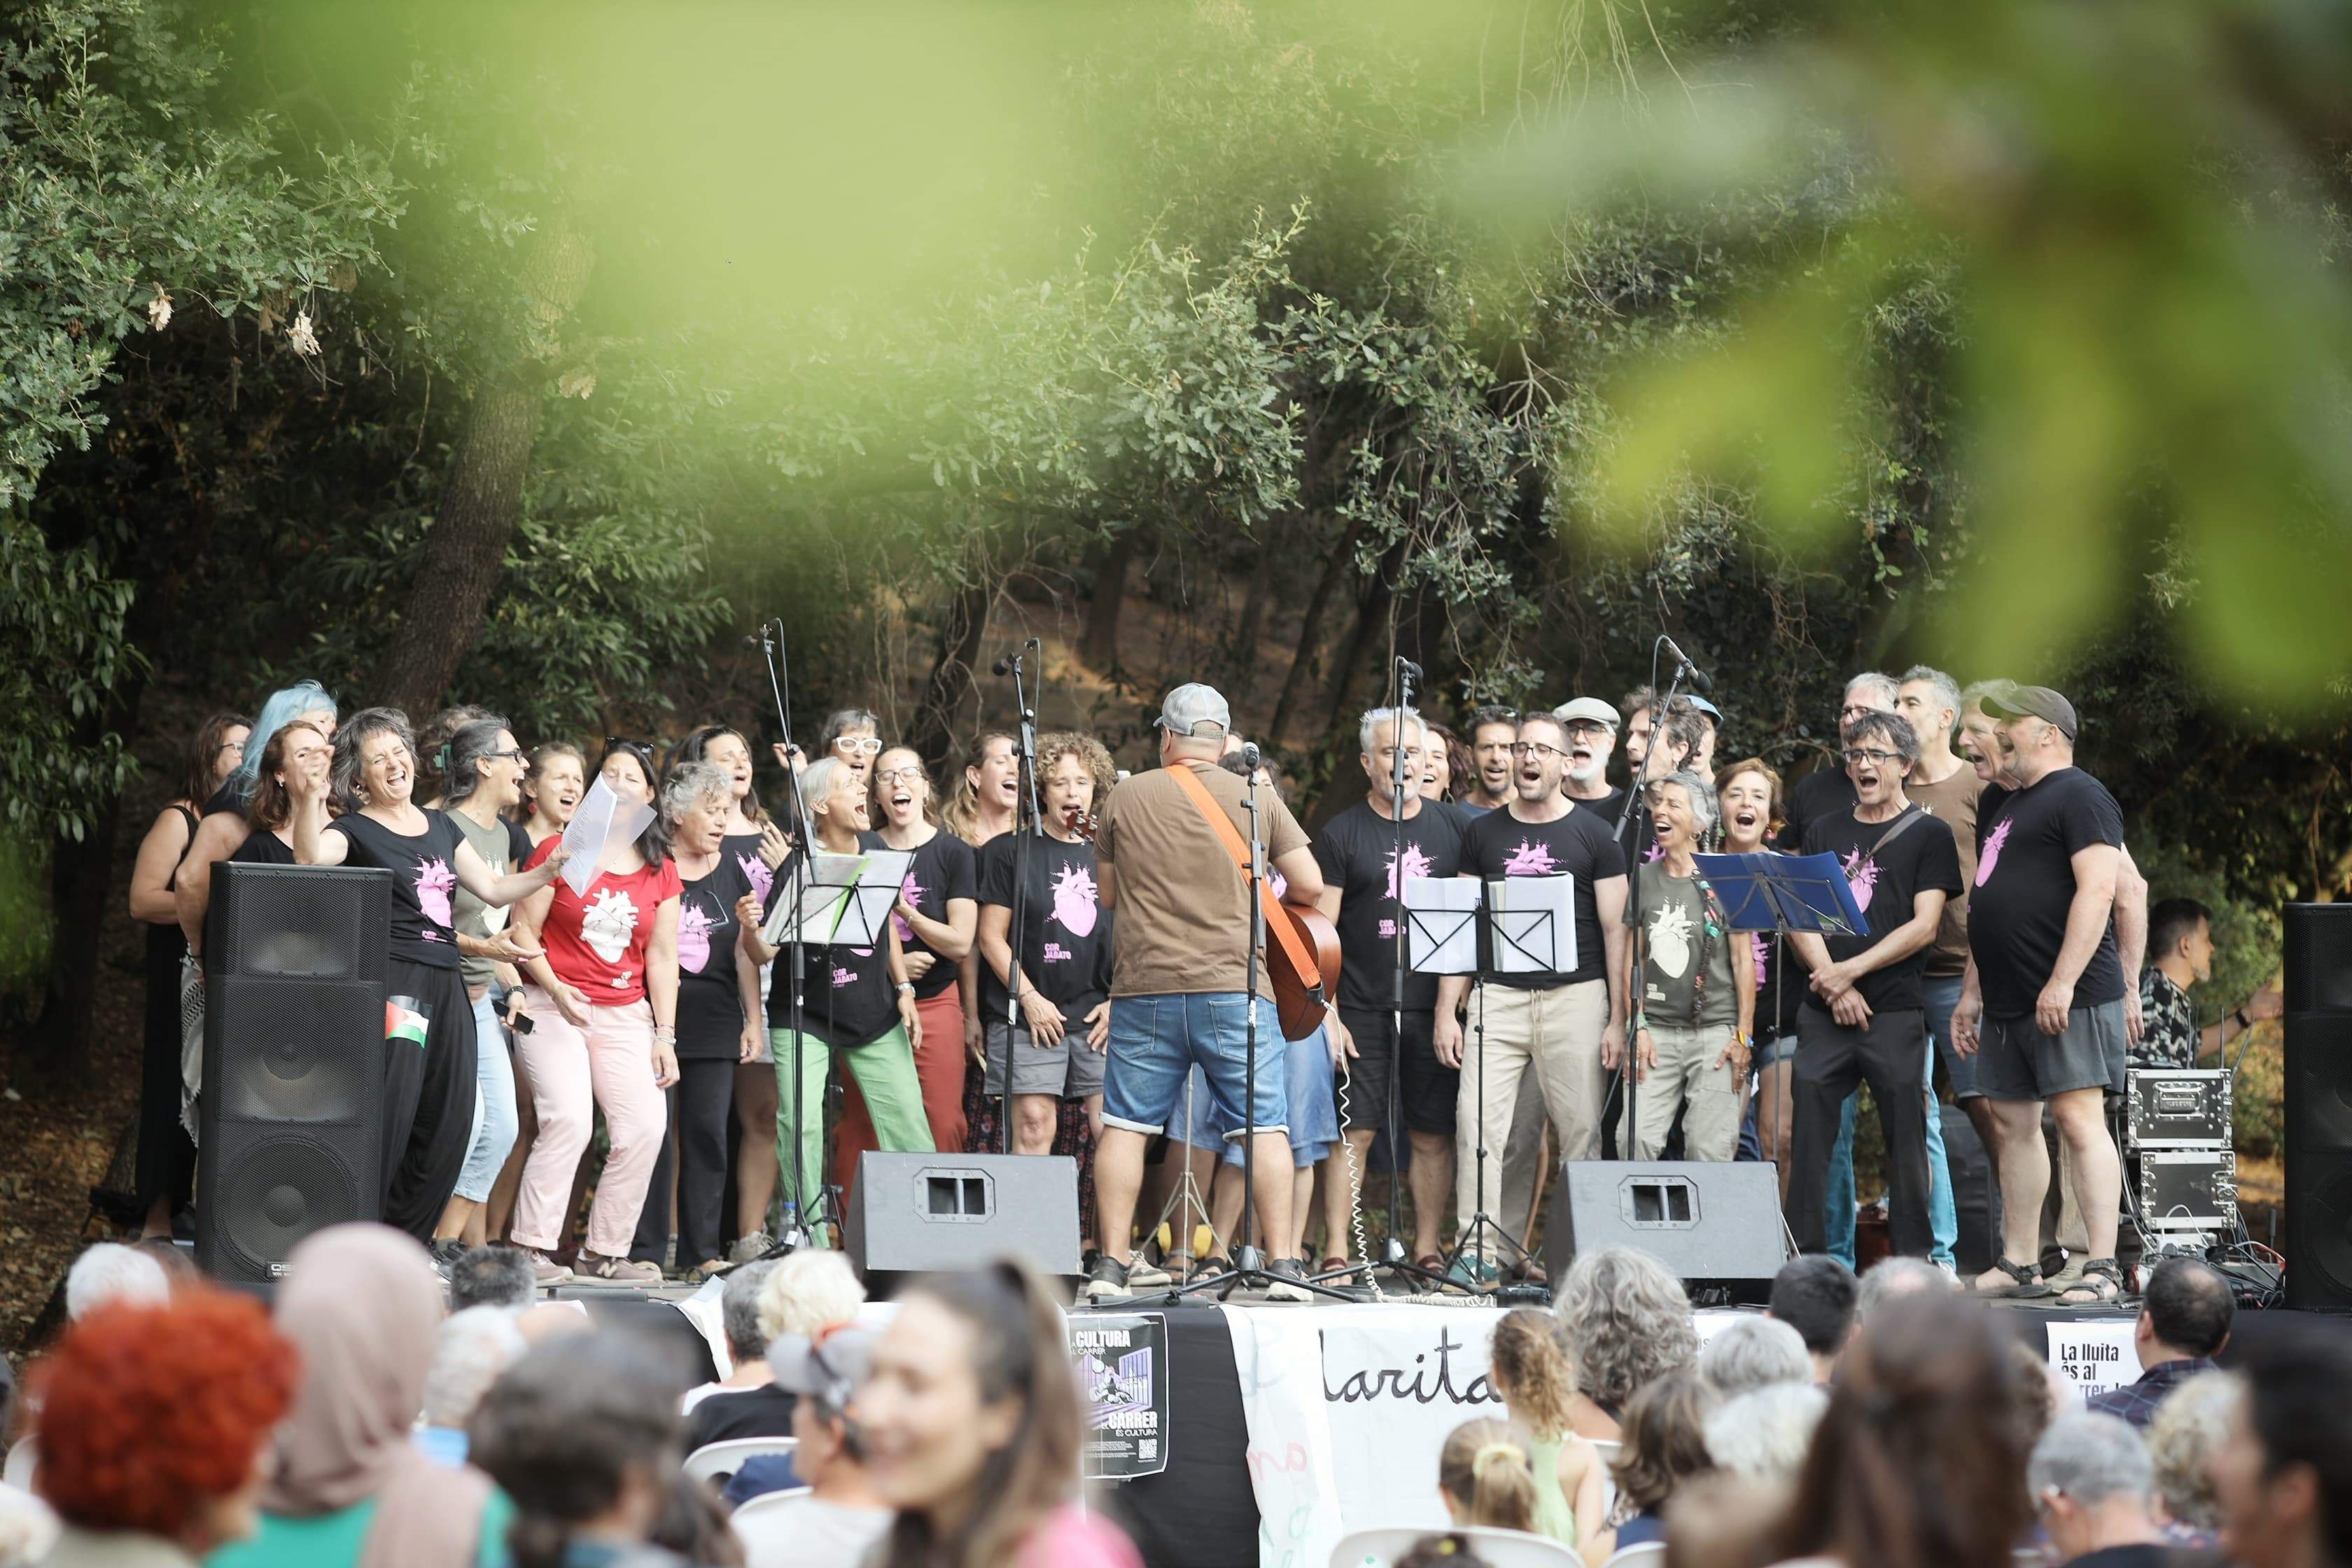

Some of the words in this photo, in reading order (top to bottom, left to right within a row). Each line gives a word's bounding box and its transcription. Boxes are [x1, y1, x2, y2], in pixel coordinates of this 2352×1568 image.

[1044, 943, 1060, 951] COR
[1043, 951, 1072, 960] JABATO
[832, 972, 858, 984] JABATO
[1075, 1330, 1131, 1348] CULTURA
[1078, 1347, 1107, 1355] CARRER
[2061, 1343, 2077, 1361] La
[2082, 1343, 2119, 1362] lluita
[2083, 1363, 2096, 1380] al
[1108, 1411, 1158, 1429] CARRER
[1124, 1429, 1158, 1437] CULTURA
